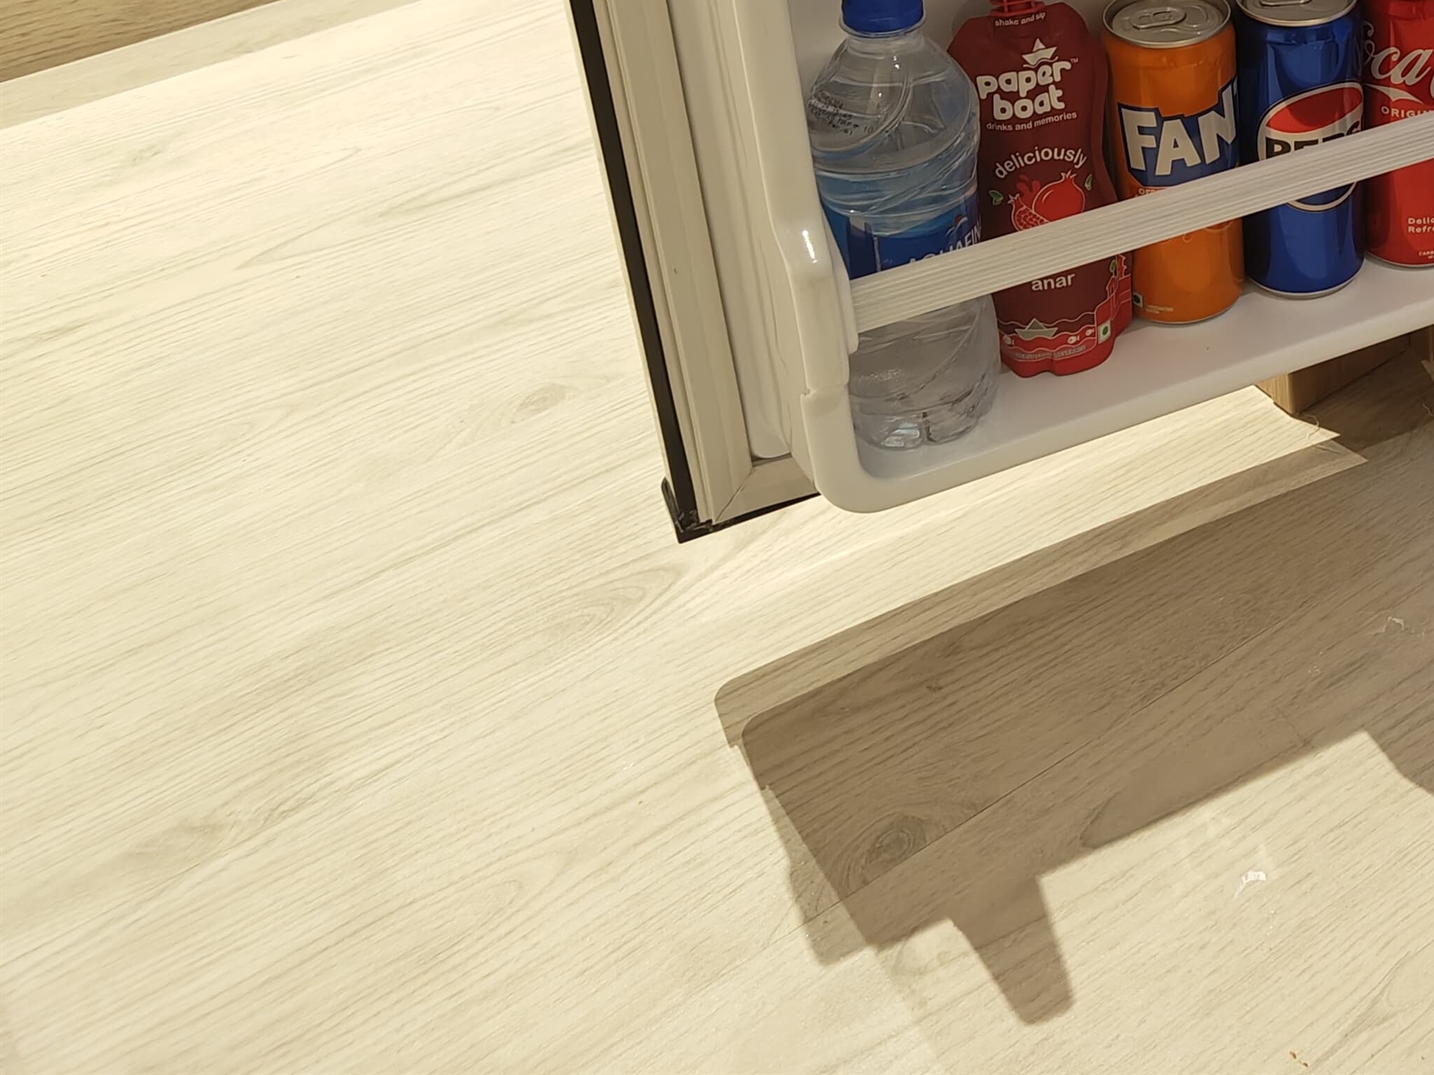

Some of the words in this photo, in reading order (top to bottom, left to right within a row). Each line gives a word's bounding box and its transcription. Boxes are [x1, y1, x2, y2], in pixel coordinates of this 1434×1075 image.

[995, 18, 1019, 26] shake
[1020, 15, 1035, 25] and
[1036, 11, 1046, 21] sip
[976, 60, 1072, 100] paper
[993, 84, 1065, 121] boat
[986, 122, 1013, 131] drinks
[1015, 121, 1033, 131] and
[1034, 111, 1077, 128] memories
[1121, 75, 1238, 176] FAN
[994, 145, 1087, 179] deliciously
[1031, 273, 1076, 291] anar
